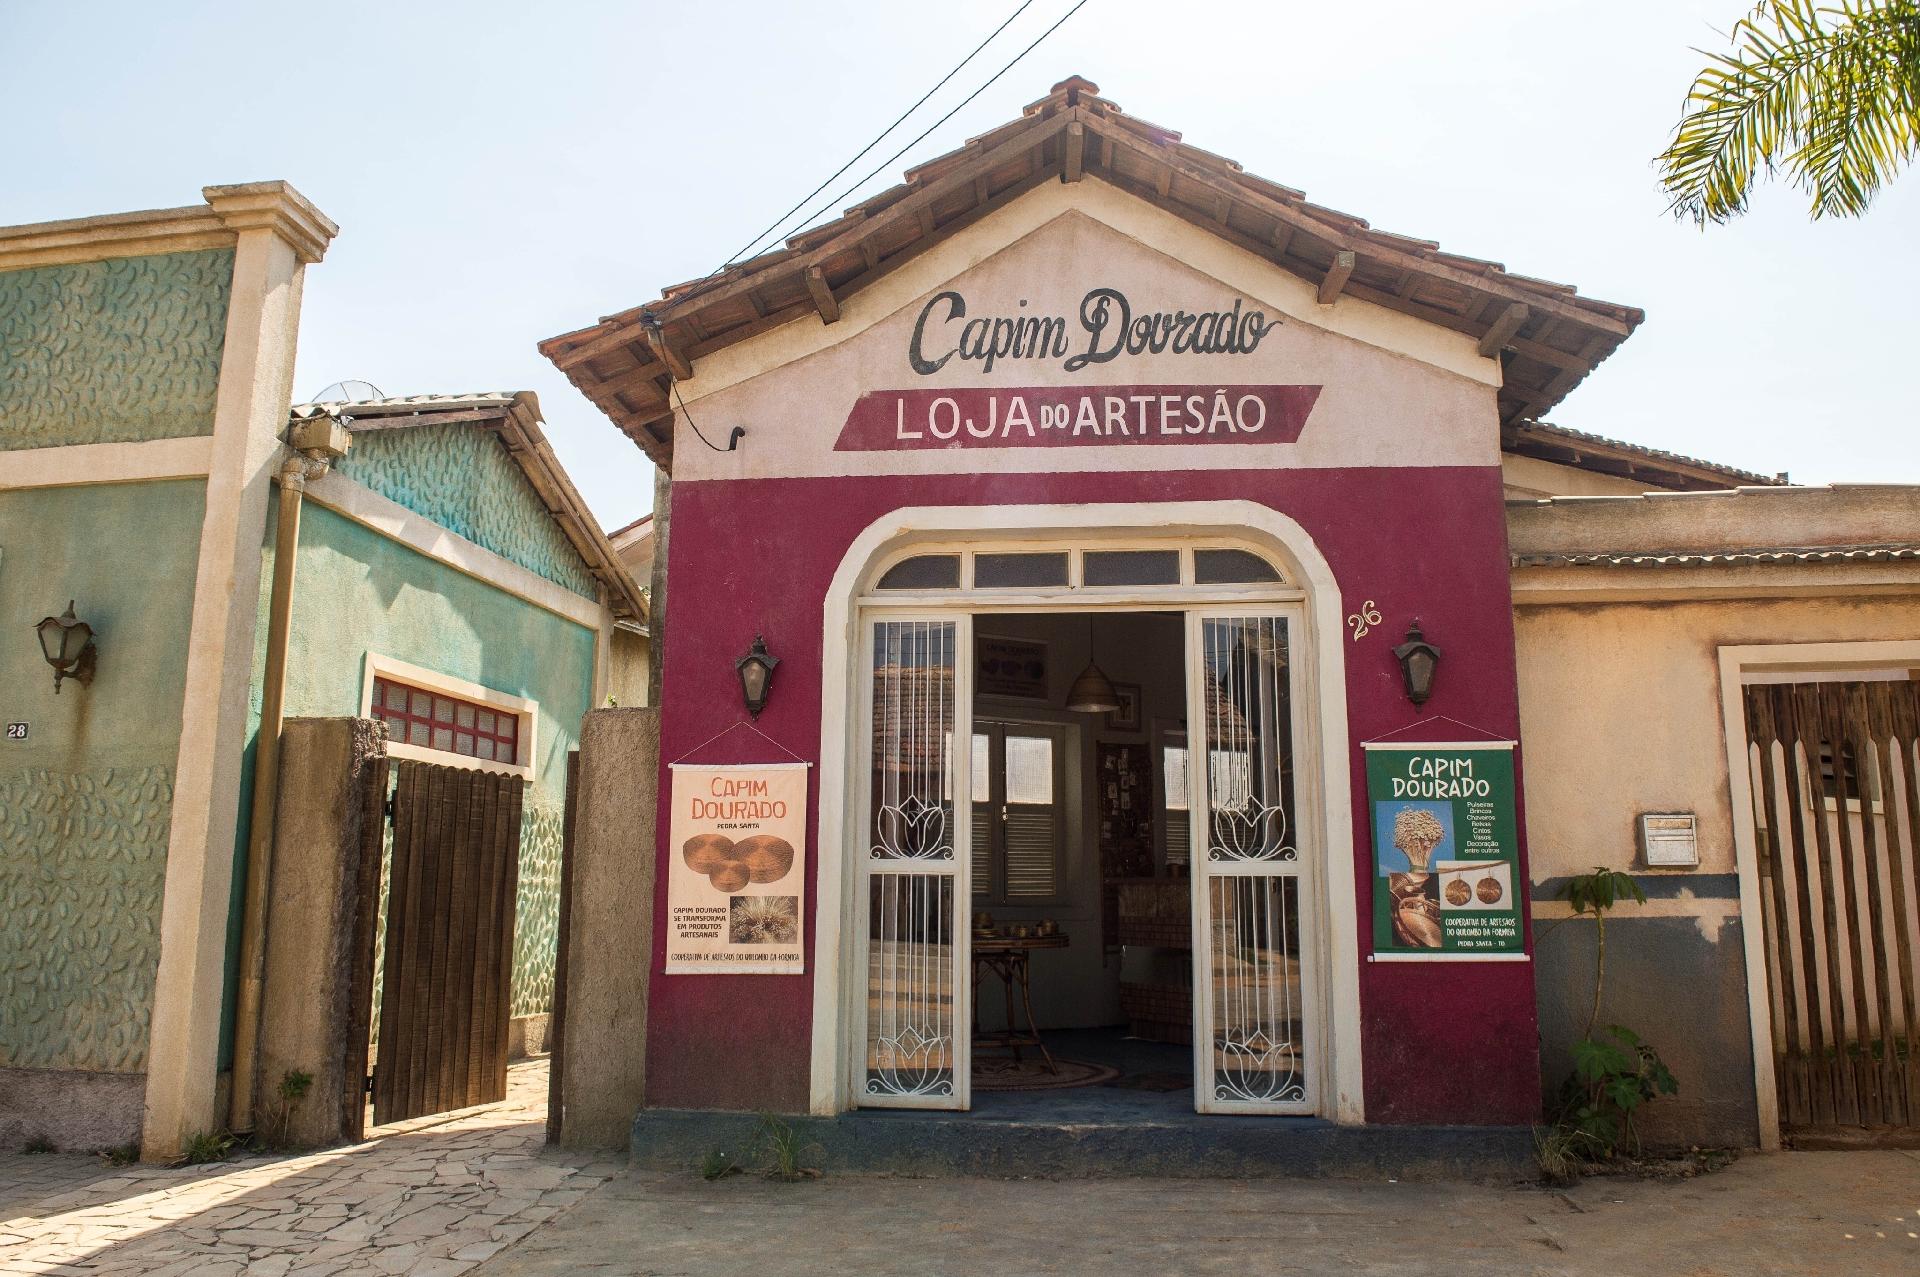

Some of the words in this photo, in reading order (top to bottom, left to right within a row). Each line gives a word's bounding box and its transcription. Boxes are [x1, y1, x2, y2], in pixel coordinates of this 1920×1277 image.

[908, 291, 1069, 376] Capim
[896, 395, 1036, 440] LOJA
[1040, 403, 1070, 430] DO
[1072, 388, 1267, 437] ARTESÃO
[1347, 600, 1382, 642] 26
[7, 724, 26, 738] 28
[1408, 756, 1473, 779] CAPIM
[711, 776, 768, 797] CAPIM
[1391, 777, 1491, 799] DOURADO
[691, 797, 787, 820] DOURADO
[1466, 840, 1499, 849] Decoração
[1446, 928, 1455, 936] DO
[1482, 928, 1491, 936] DA
[1480, 917, 1488, 926] DE
[680, 931, 719, 939] ARTESANAIS
